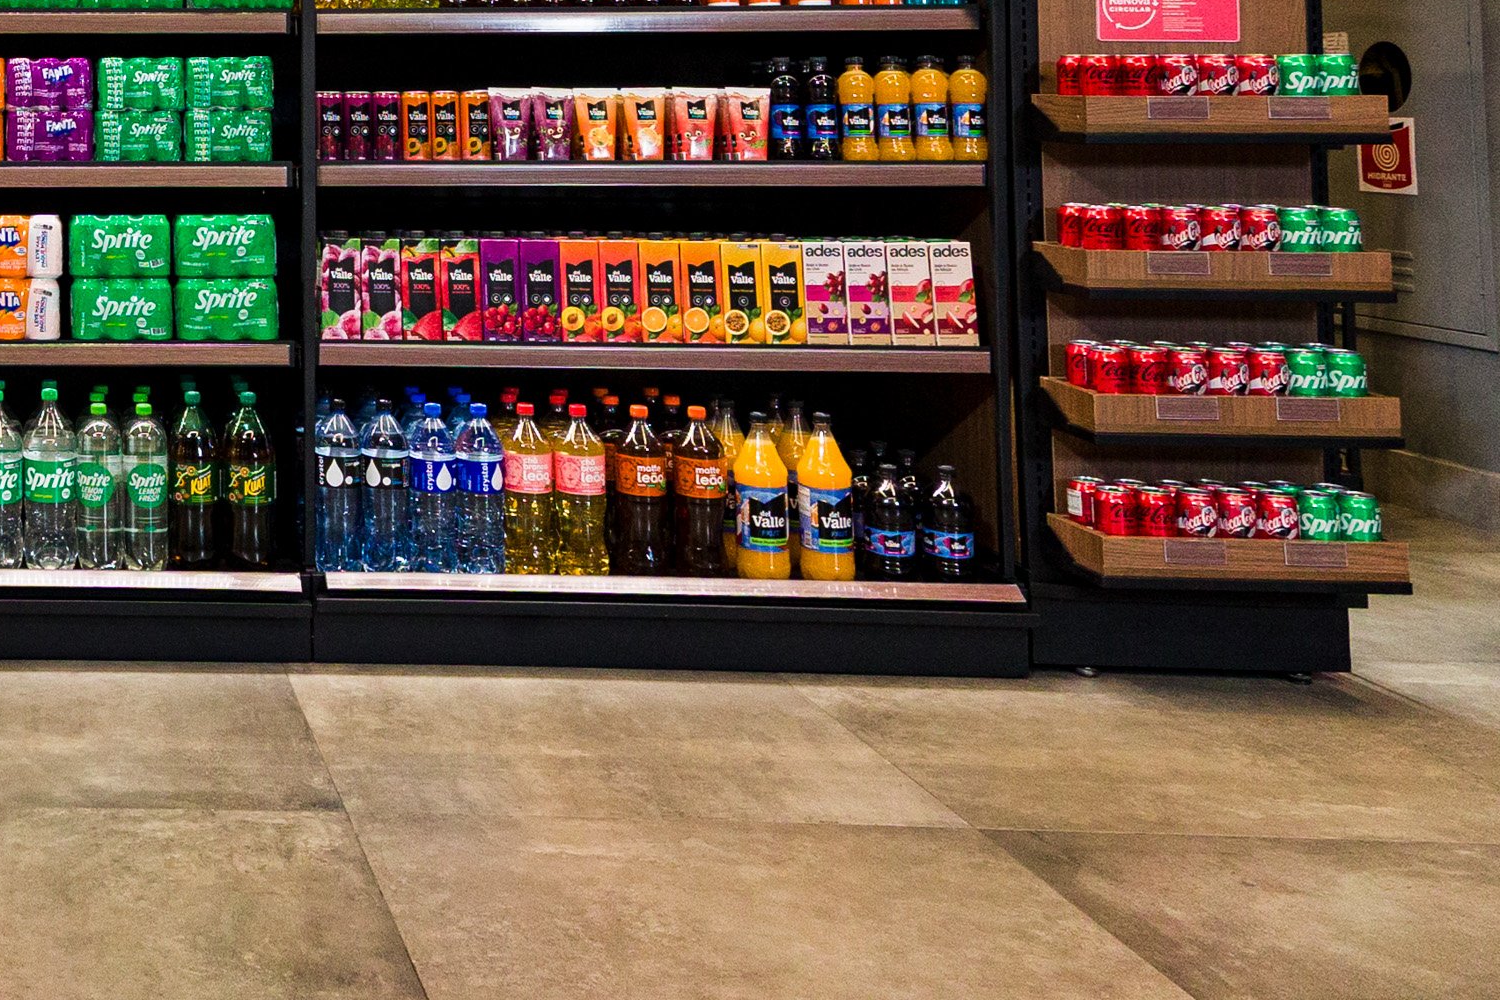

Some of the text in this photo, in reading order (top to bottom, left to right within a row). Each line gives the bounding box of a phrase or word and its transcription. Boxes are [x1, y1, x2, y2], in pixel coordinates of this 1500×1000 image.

[1368, 172, 1407, 181] HIDRANTE
[92, 228, 153, 252] Sprite
[192, 226, 256, 249] Sprite
[805, 245, 840, 257] ades
[848, 245, 882, 257] ades
[890, 245, 925, 257] ades
[933, 245, 969, 257] ades
[410, 272, 433, 280] Valle
[450, 272, 473, 280] Valle
[648, 274, 672, 283] Valle
[731, 275, 754, 284] Valle
[194, 289, 258, 312] Sprite
[92, 296, 156, 319] Sprite
[695, 466, 720, 474] matte
[26, 465, 75, 490] Sprite
[129, 472, 165, 490] Sprite
[695, 473, 724, 485] leão
[752, 516, 785, 528] Valle
[821, 516, 851, 528] Valle
[1341, 513, 1381, 535] Spri
